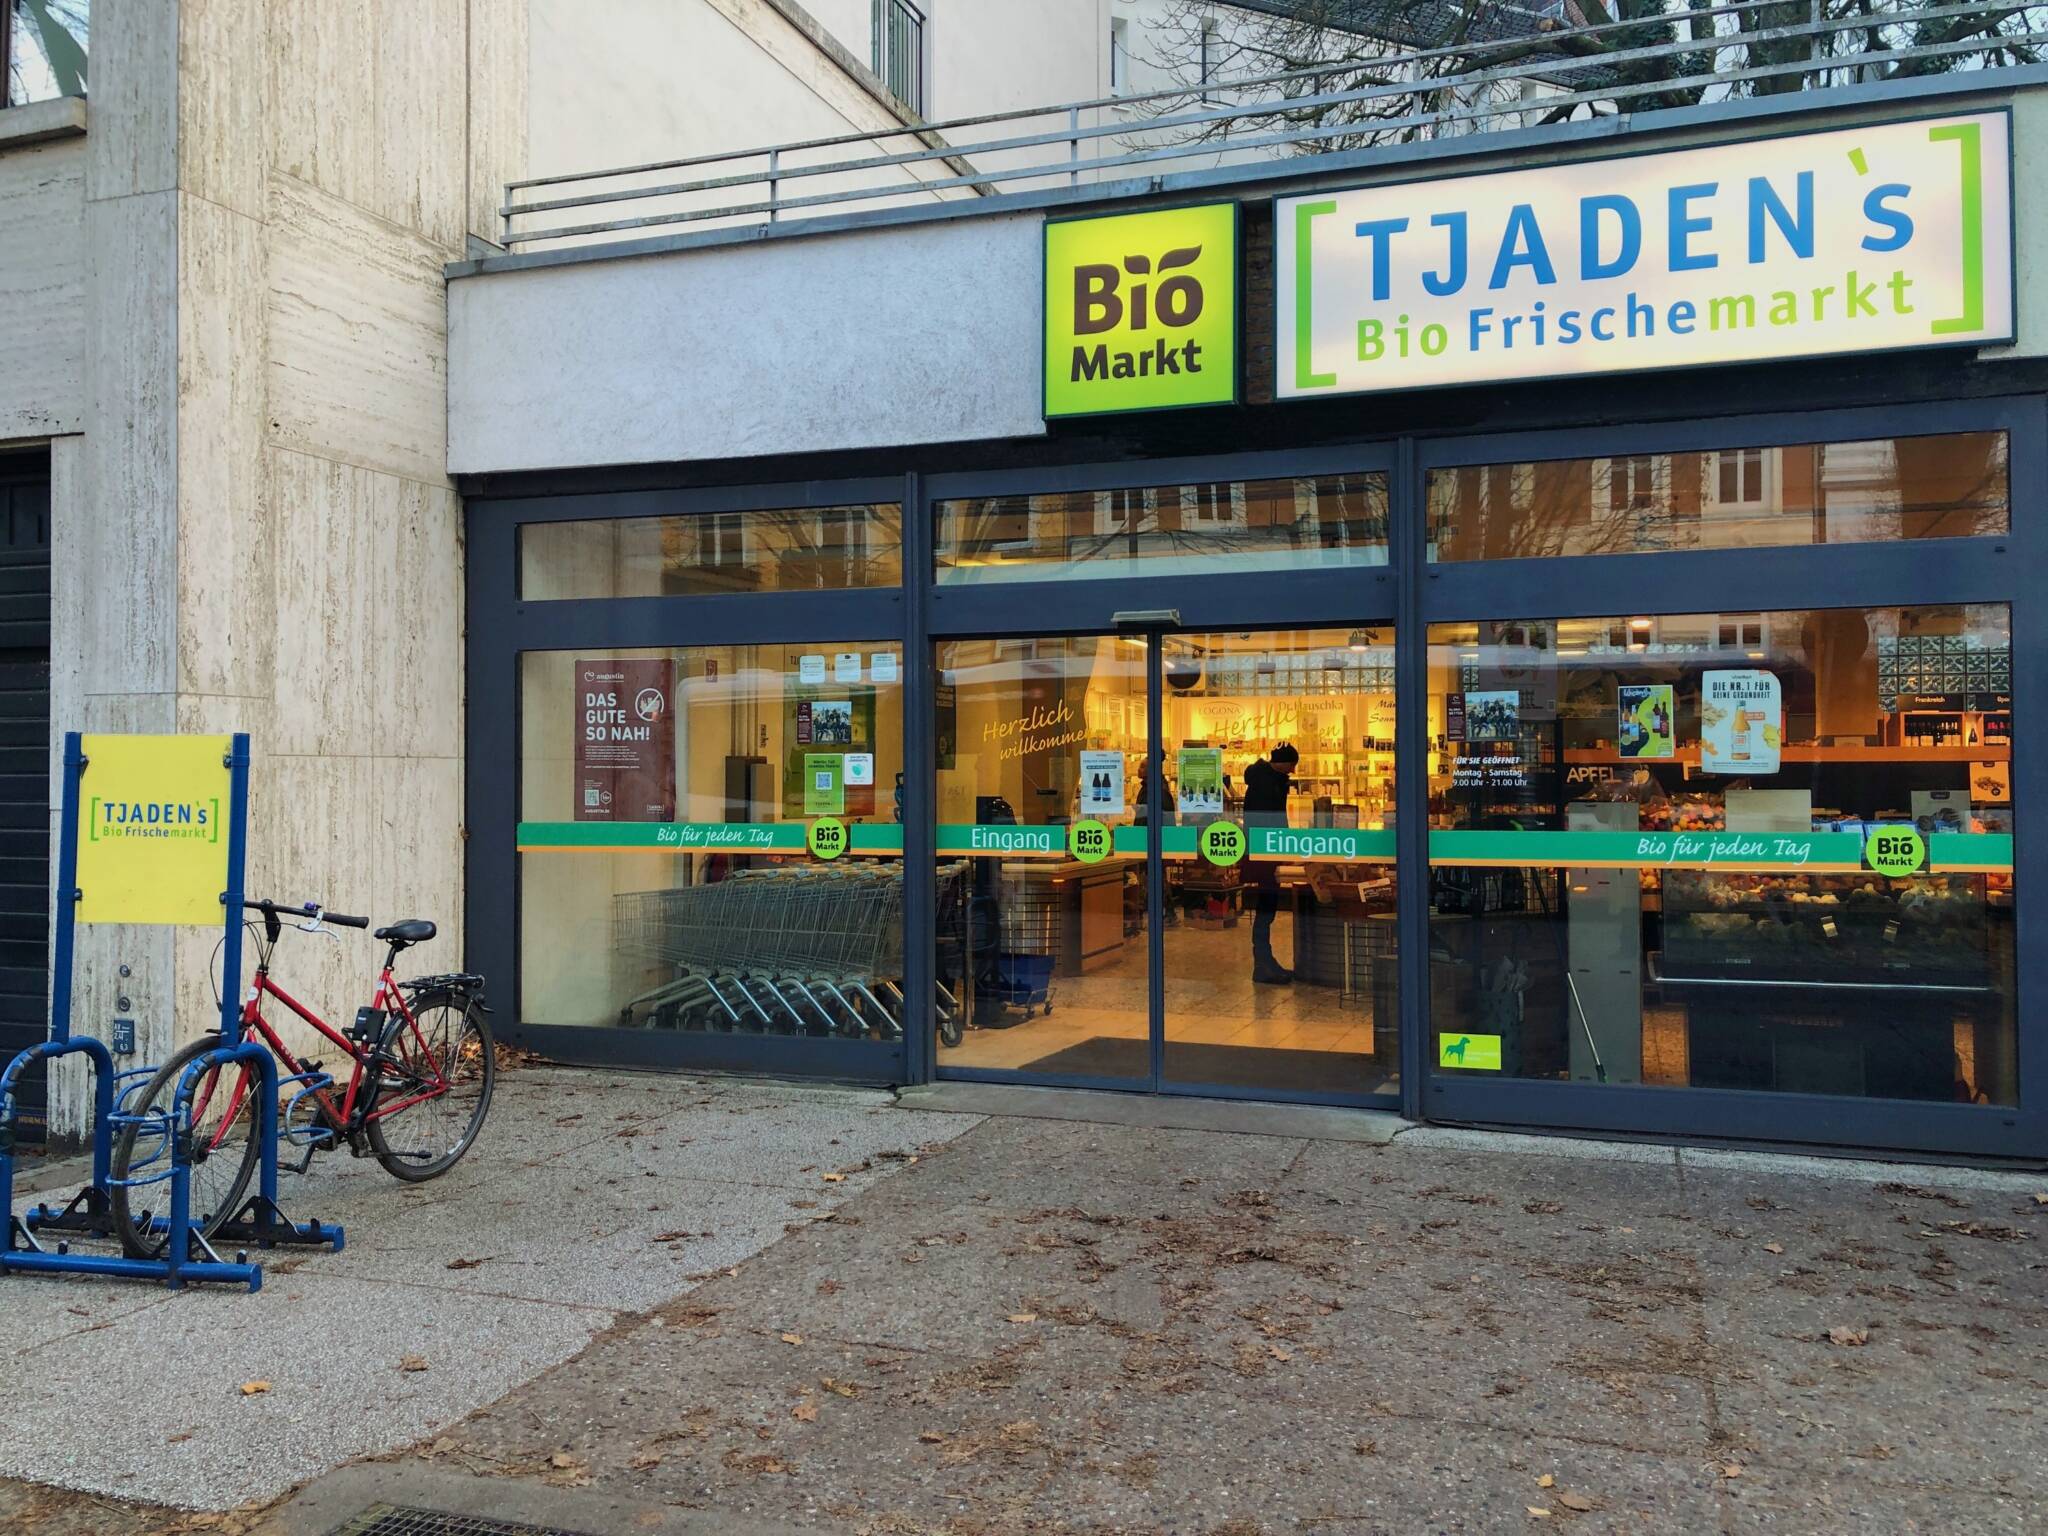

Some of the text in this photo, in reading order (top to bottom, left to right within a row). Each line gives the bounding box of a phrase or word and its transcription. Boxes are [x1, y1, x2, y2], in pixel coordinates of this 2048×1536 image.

[1073, 244, 1204, 336] Bio
[1070, 337, 1202, 382] Markt
[1712, 682, 1726, 691] DIE
[586, 692, 617, 707] DAS
[586, 709, 626, 724] GUTE
[983, 699, 1075, 743] Herzlich
[586, 726, 650, 741] SO NAH!
[1452, 755, 1521, 765] FÜR SIE GEÖFFNET
[1453, 769, 1482, 778] Montag
[1489, 768, 1523, 778] Samstag
[1453, 778, 1469, 787] 9.00
[1470, 778, 1484, 786] Uhr
[1514, 778, 1528, 786] Uhr
[657, 825, 774, 850] Bio für jeden Tag
[816, 827, 840, 842] Bio
[971, 827, 1050, 853] Eingang
[1077, 829, 1104, 845] Bio
[1210, 831, 1238, 847] Bio
[815, 841, 840, 851] Markt
[1076, 845, 1104, 854] Markt
[1266, 830, 1356, 859] Eingang
[1637, 835, 1812, 865] Bio für jeden Tag
[1877, 836, 1914, 855] Bio
[1209, 848, 1238, 857] Markt
[1876, 856, 1914, 866] Markt
